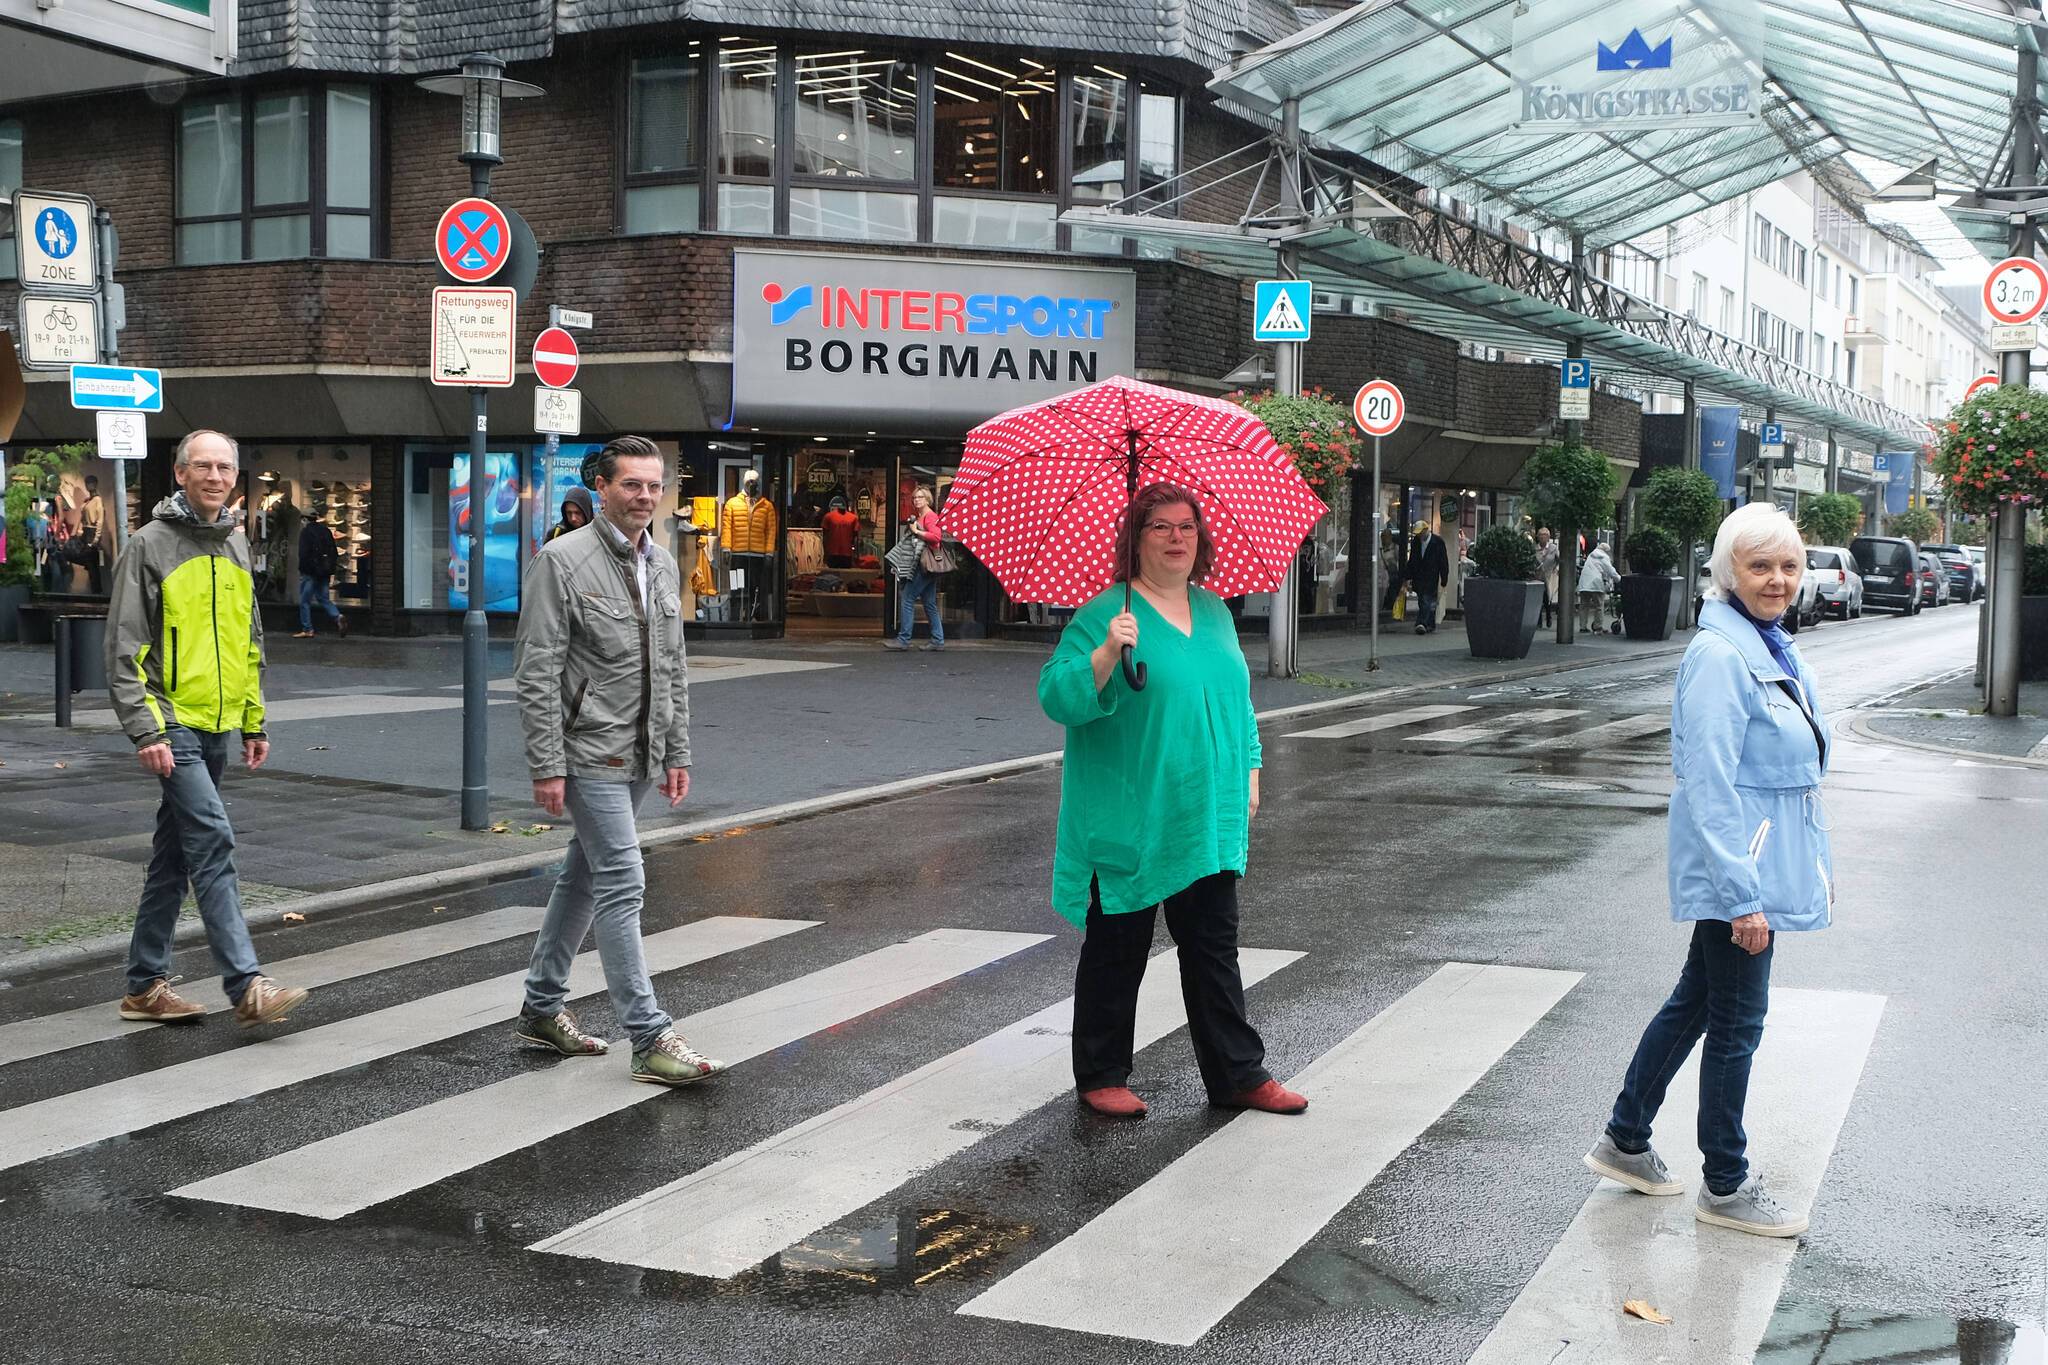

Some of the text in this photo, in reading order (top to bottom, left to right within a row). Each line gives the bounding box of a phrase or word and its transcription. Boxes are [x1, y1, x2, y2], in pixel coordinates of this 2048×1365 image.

[41, 264, 77, 281] ZONE
[440, 295, 509, 310] Rettungsweg
[2022, 290, 2035, 302] m
[459, 314, 495, 325] FÜR DIE
[820, 286, 1113, 340] INTERSPORT
[459, 330, 507, 339] FEUERWEHR
[54, 345, 73, 357] frei
[784, 337, 1097, 383] BORGMANN
[1568, 362, 1584, 384] P
[1368, 397, 1391, 420] 20
[548, 420, 562, 429] frei
[1766, 426, 1778, 442] P
[1876, 457, 1886, 469] P
